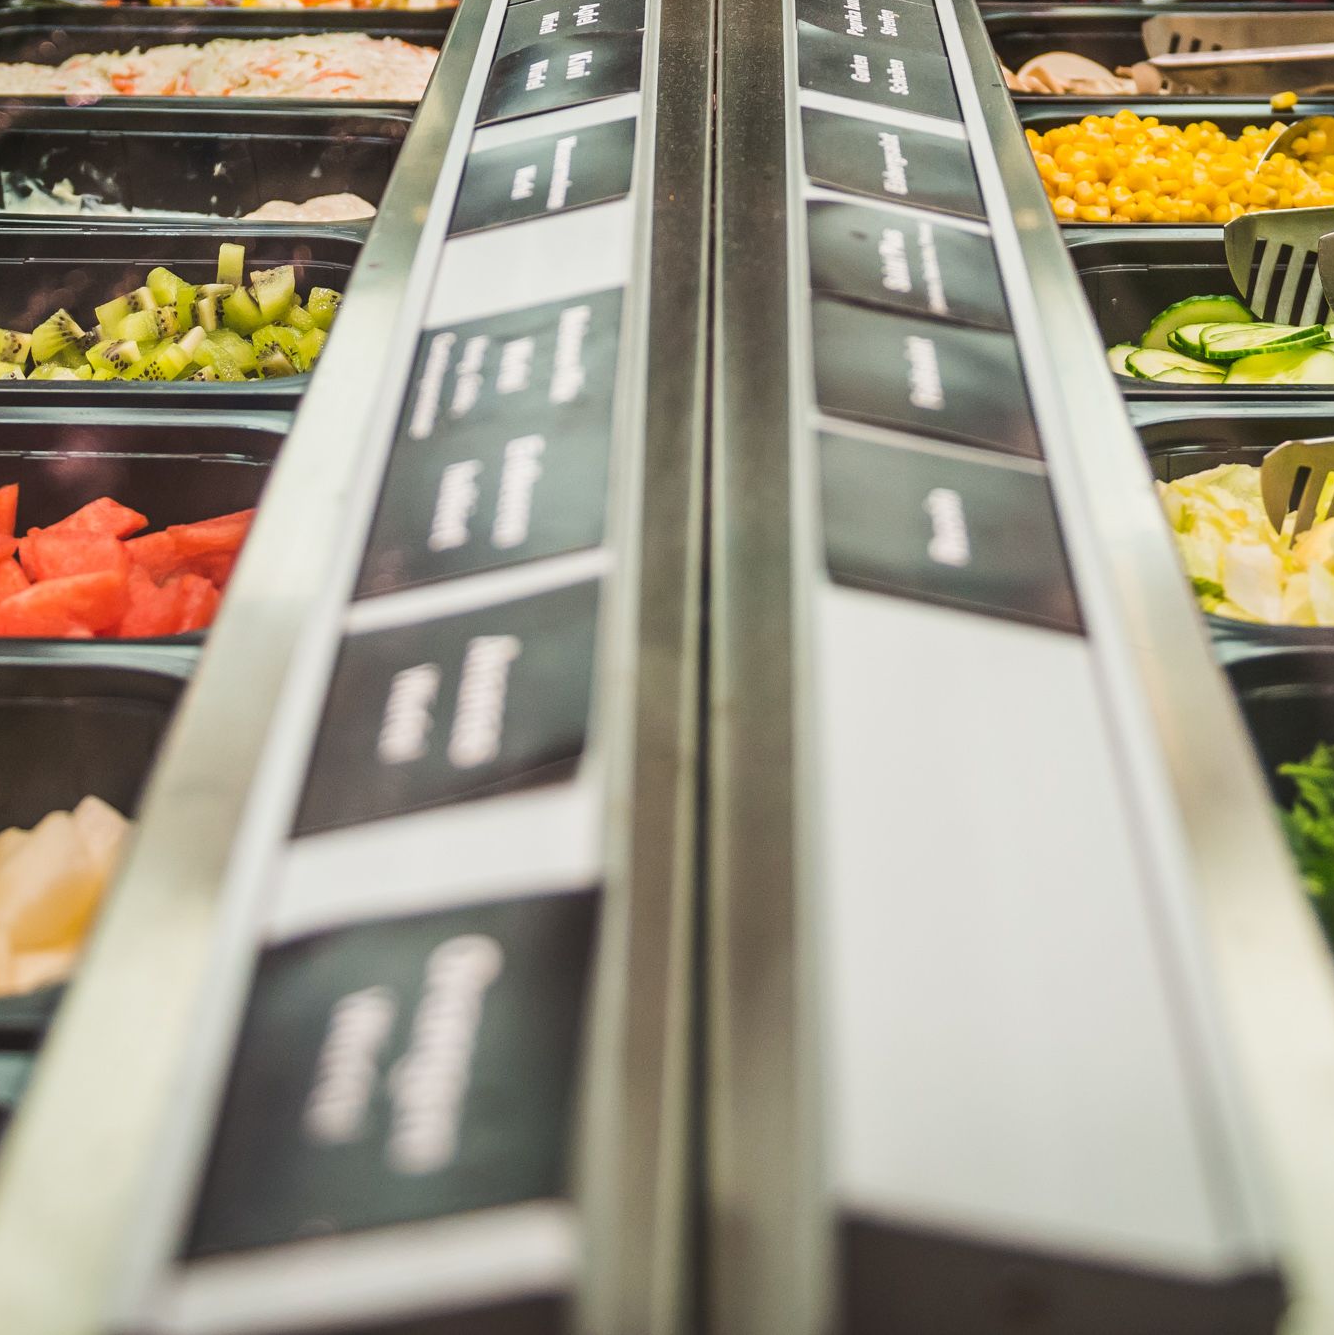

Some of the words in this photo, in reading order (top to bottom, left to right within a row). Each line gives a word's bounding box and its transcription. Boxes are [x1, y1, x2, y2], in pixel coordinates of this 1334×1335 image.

[574, 3, 600, 27] Apfel
[846, 11, 867, 37] Paprika
[878, 9, 899, 36] Streifen
[566, 50, 593, 80] Kiwi
[849, 54, 871, 83] Gurken
[886, 58, 910, 96] Scheiben
